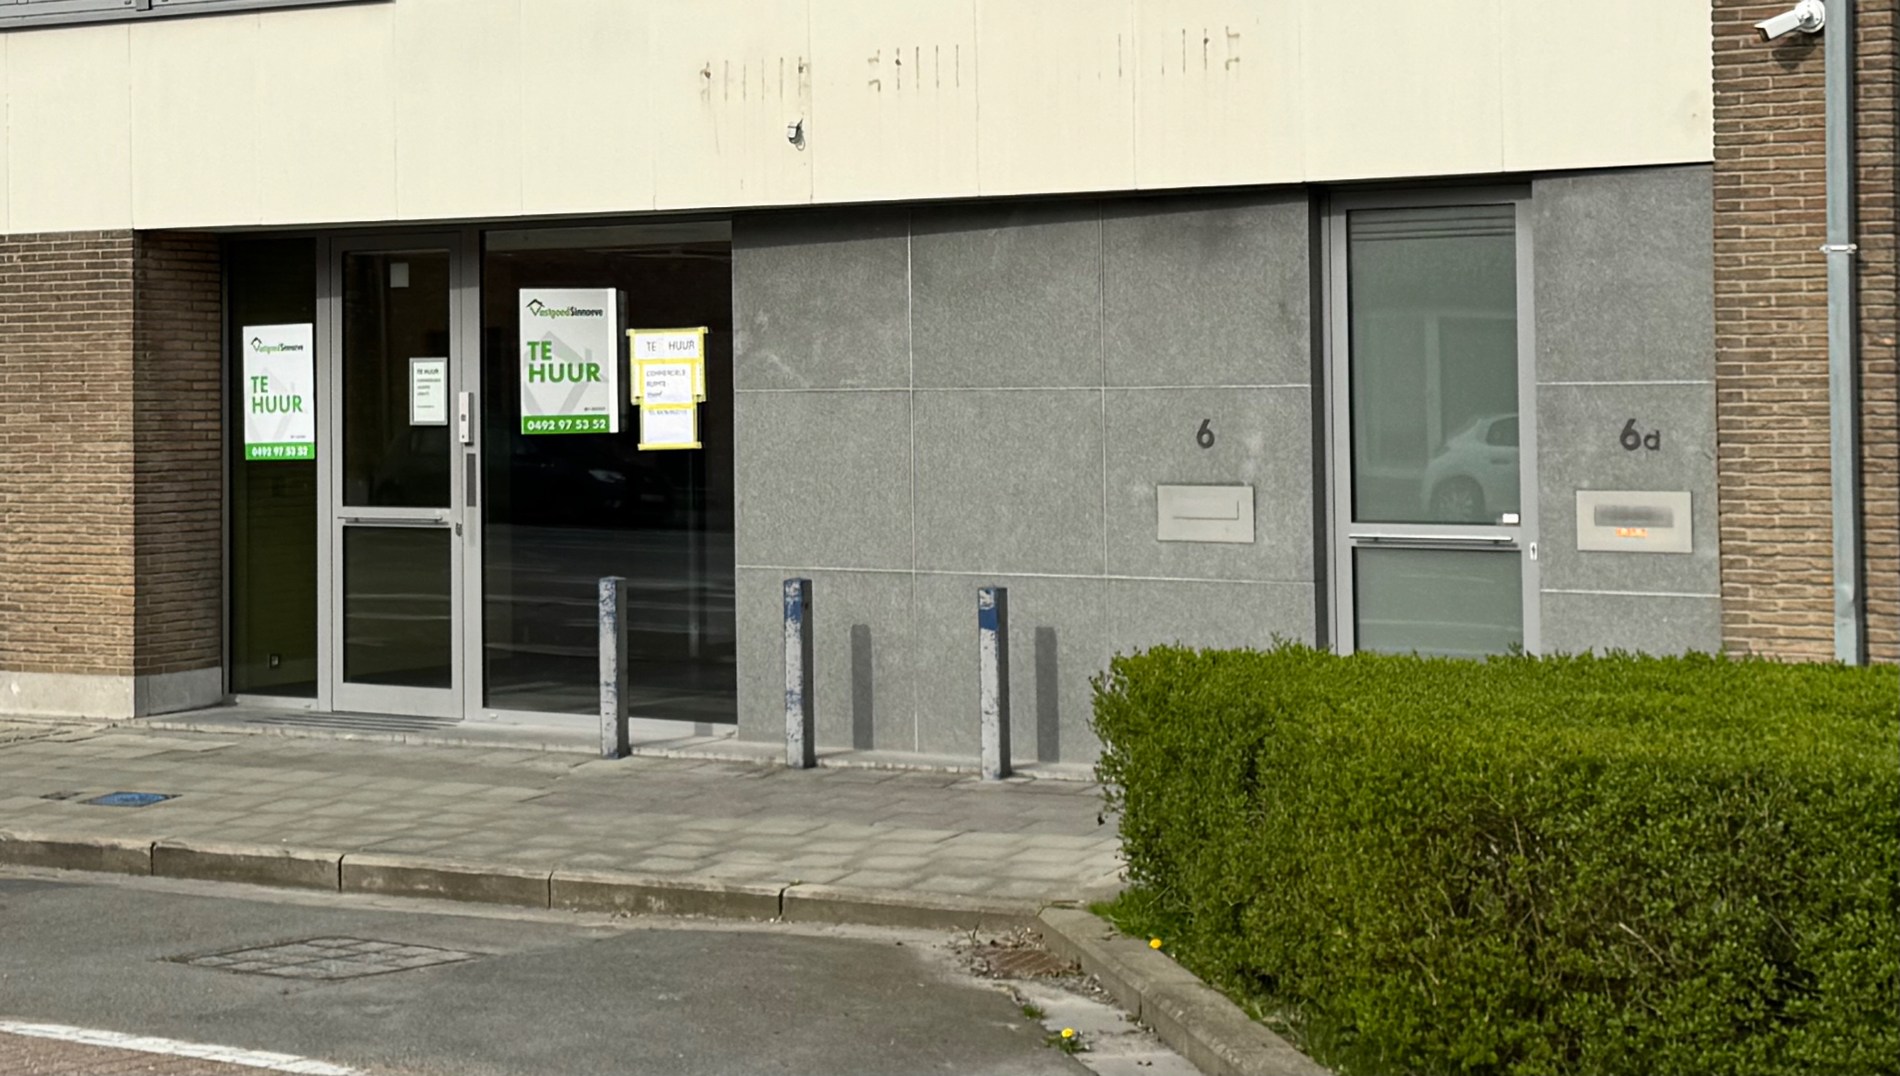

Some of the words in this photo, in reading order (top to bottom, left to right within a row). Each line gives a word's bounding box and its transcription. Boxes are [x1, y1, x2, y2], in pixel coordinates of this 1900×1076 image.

[527, 341, 553, 361] TE
[646, 341, 657, 352] TE
[668, 340, 695, 351] HUUR
[528, 362, 601, 383] HUUR
[251, 376, 268, 394] TE
[252, 395, 303, 414] HUUR
[527, 420, 555, 430] 0492
[558, 420, 572, 430] 97
[576, 419, 589, 429] 53
[592, 419, 606, 429] 52
[1196, 419, 1215, 449] 6
[1620, 418, 1660, 451] 6d
